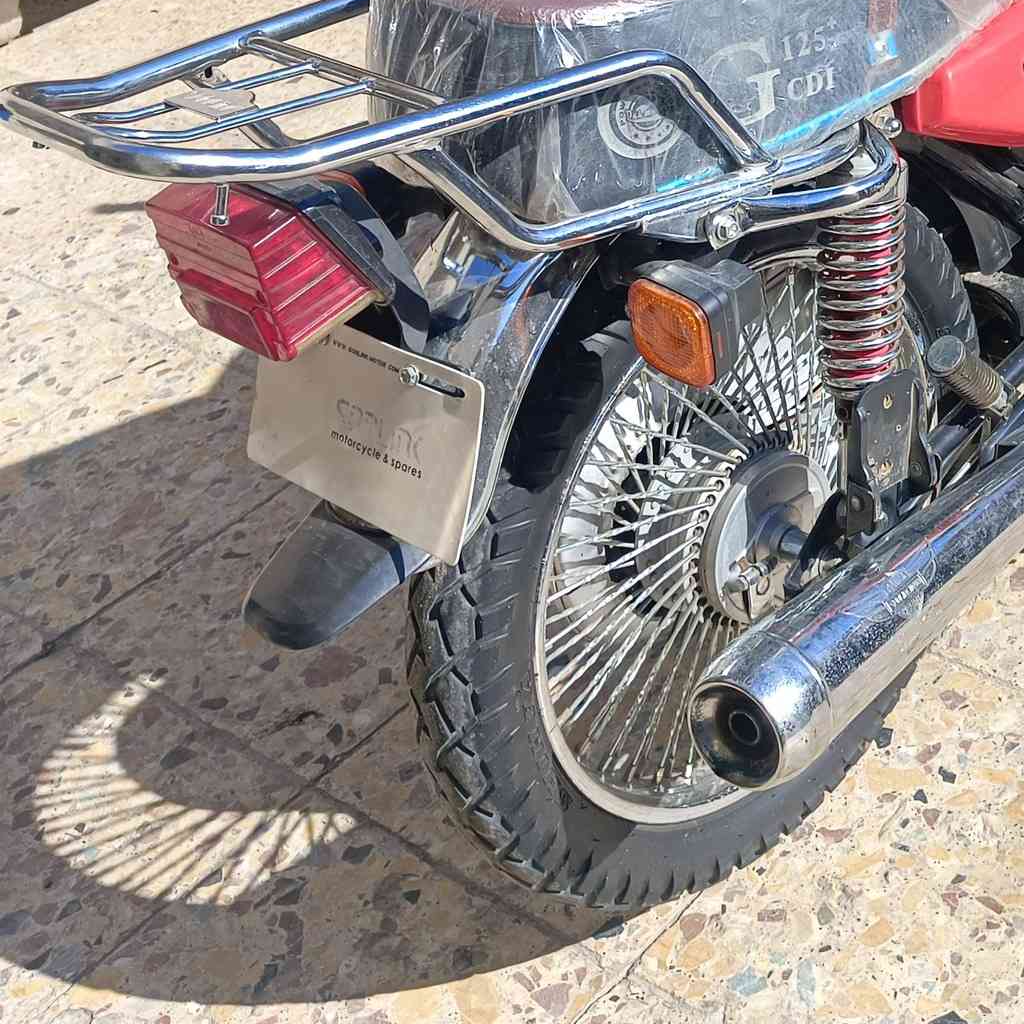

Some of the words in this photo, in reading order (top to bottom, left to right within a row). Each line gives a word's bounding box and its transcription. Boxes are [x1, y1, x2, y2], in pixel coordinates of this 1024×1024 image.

[786, 66, 836, 101] CDI
[330, 429, 382, 461] motorcycle
[391, 457, 423, 480] spares
